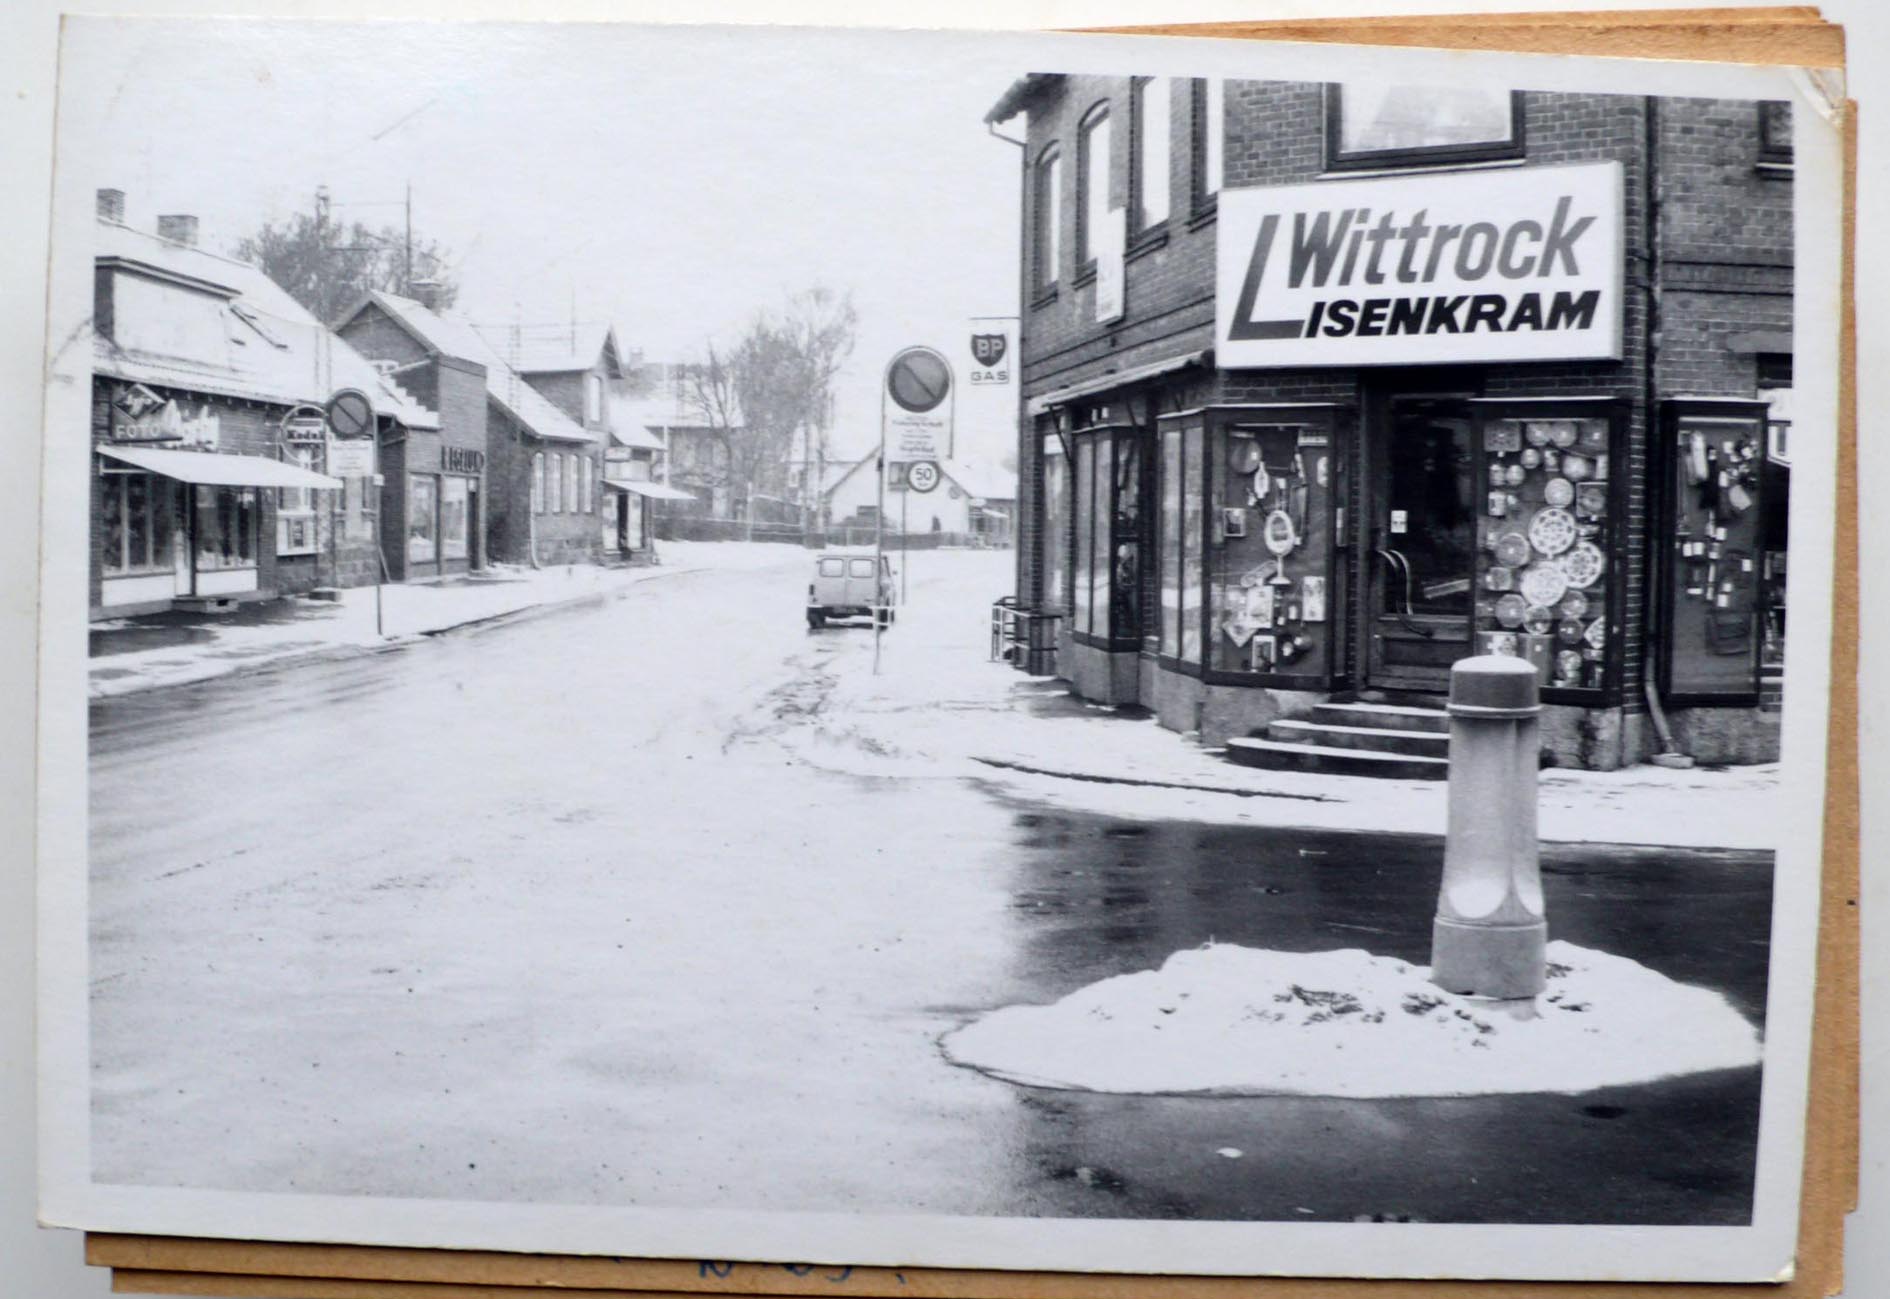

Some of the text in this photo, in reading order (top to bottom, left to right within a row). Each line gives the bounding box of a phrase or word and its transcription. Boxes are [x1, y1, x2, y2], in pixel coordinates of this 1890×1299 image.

[1287, 195, 1598, 289] Wittrock
[975, 337, 1005, 358] BP
[971, 370, 1009, 382] GAS
[115, 424, 161, 440] FOTO
[915, 467, 933, 482] 50
